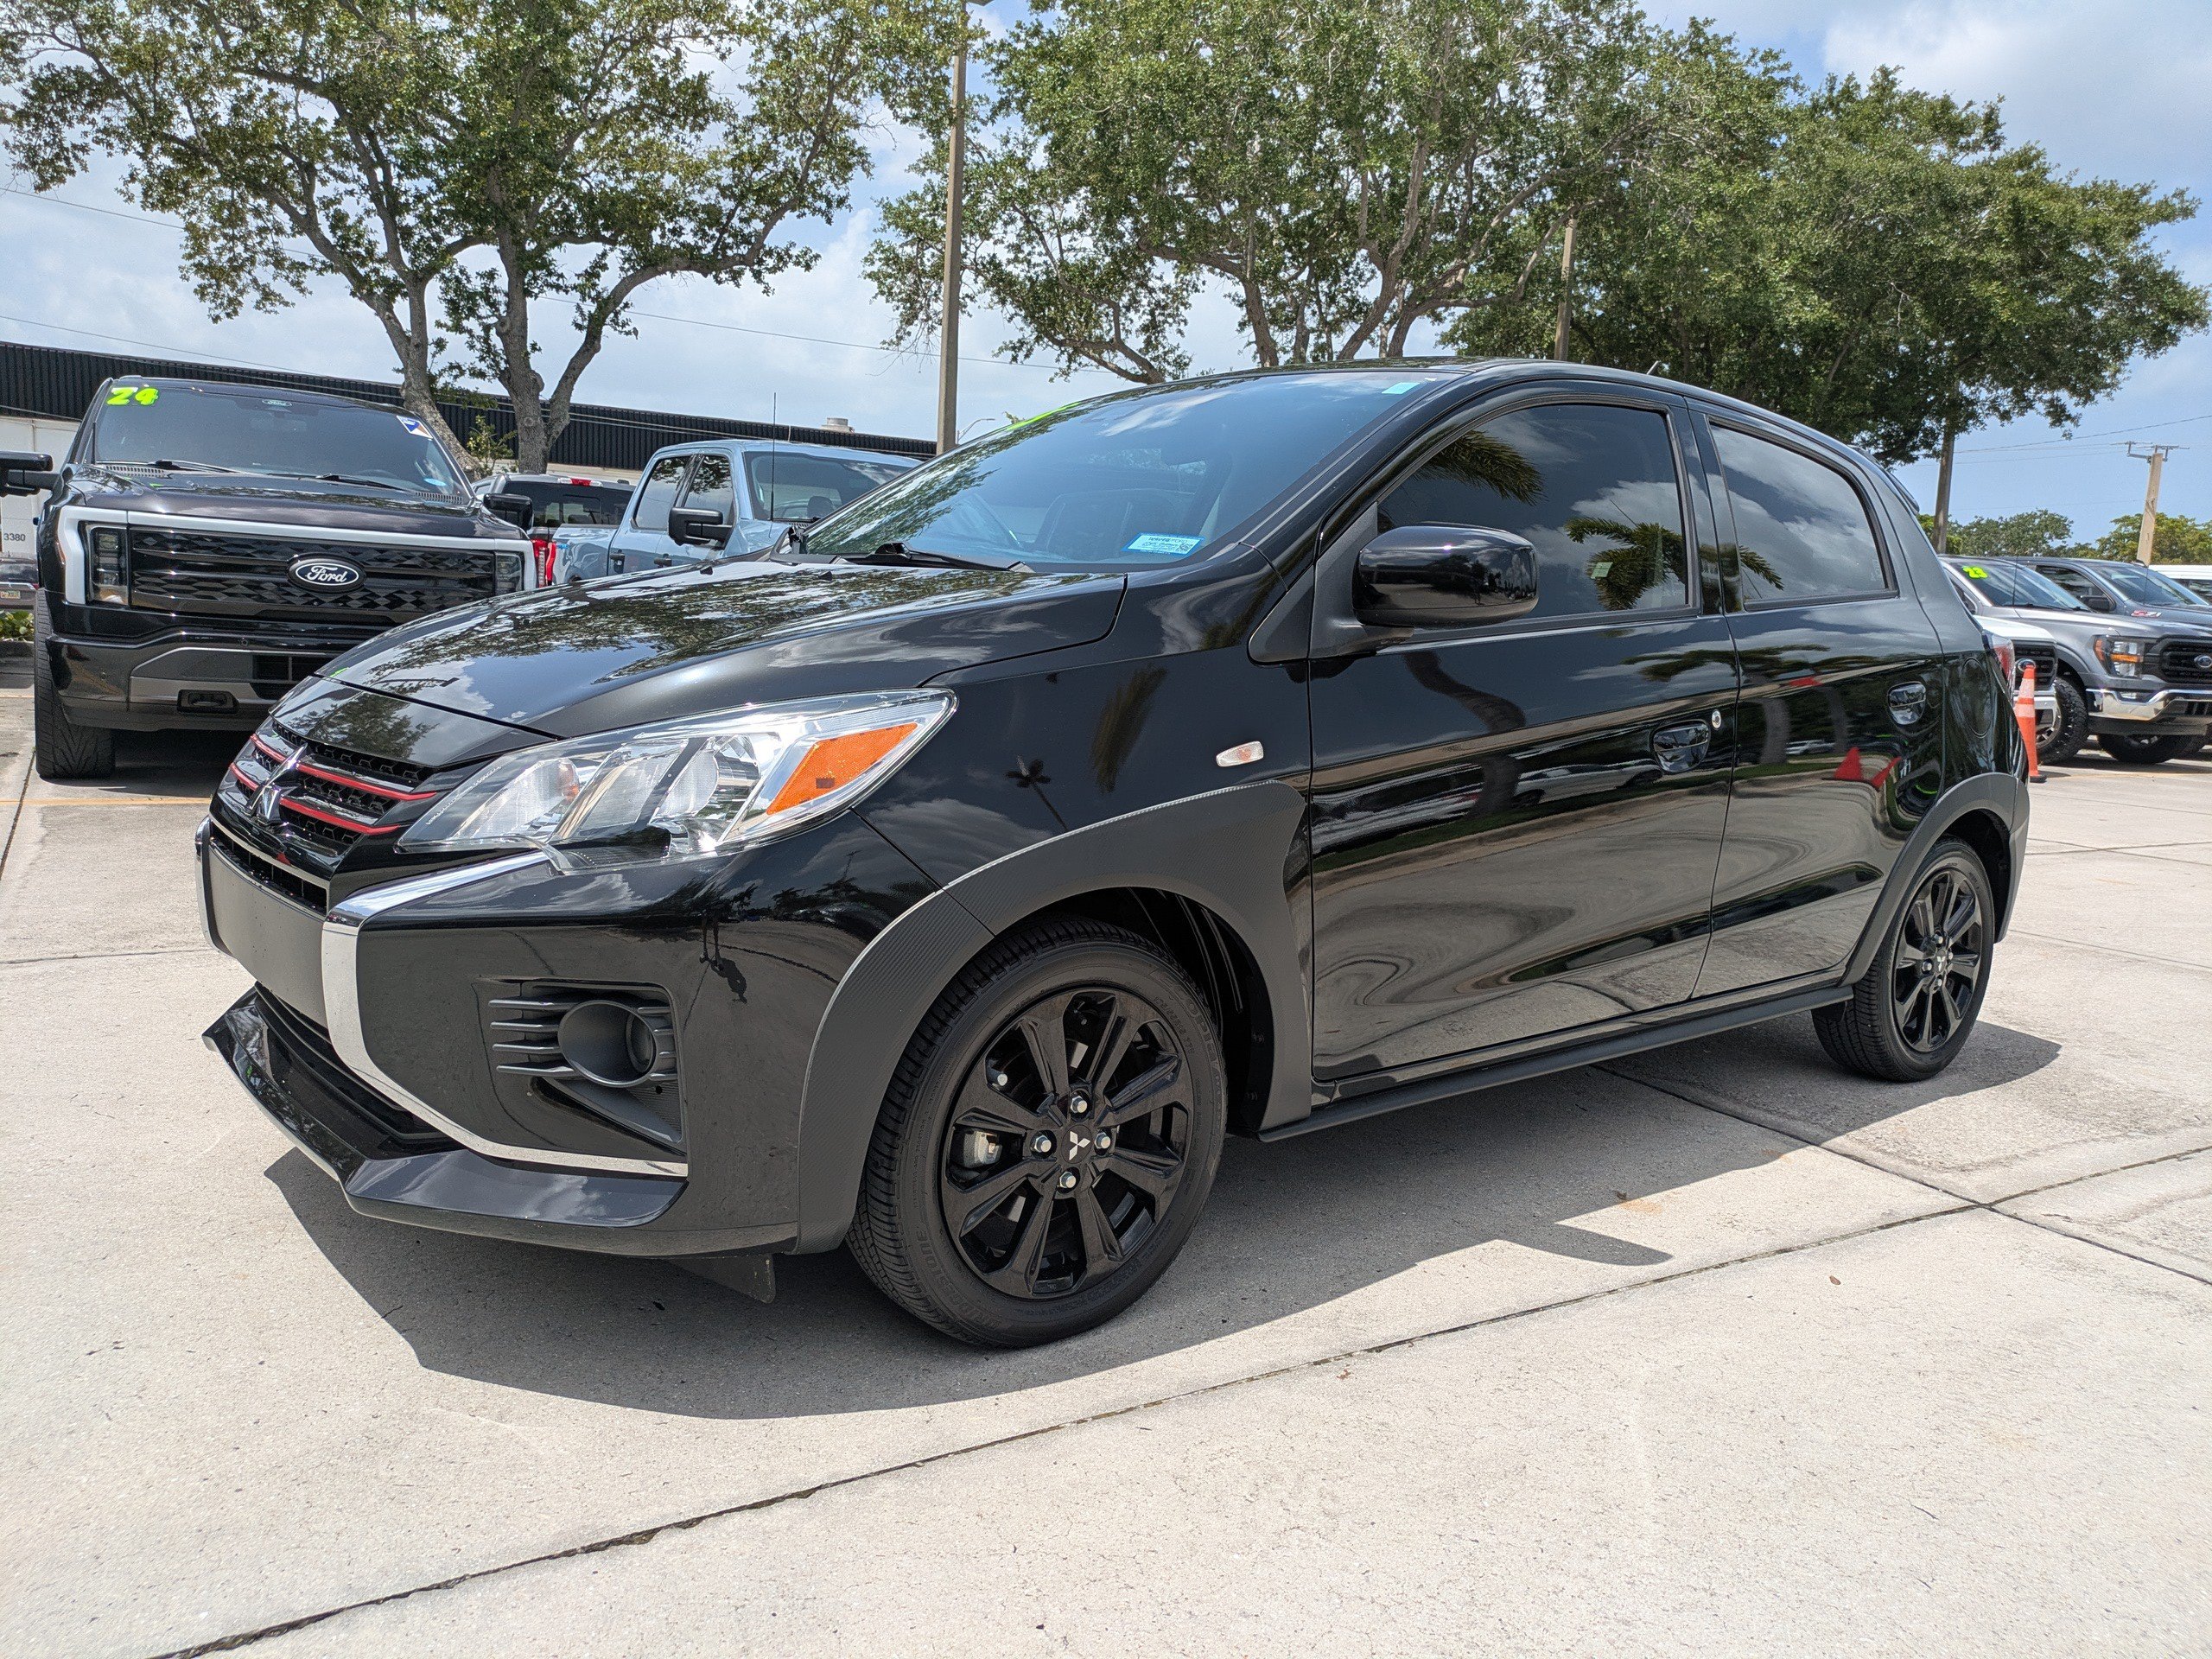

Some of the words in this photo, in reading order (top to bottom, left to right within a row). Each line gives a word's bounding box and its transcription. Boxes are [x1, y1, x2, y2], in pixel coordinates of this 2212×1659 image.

[107, 387, 159, 405] 24
[3, 532, 26, 542] 3380
[305, 565, 347, 582] Ford
